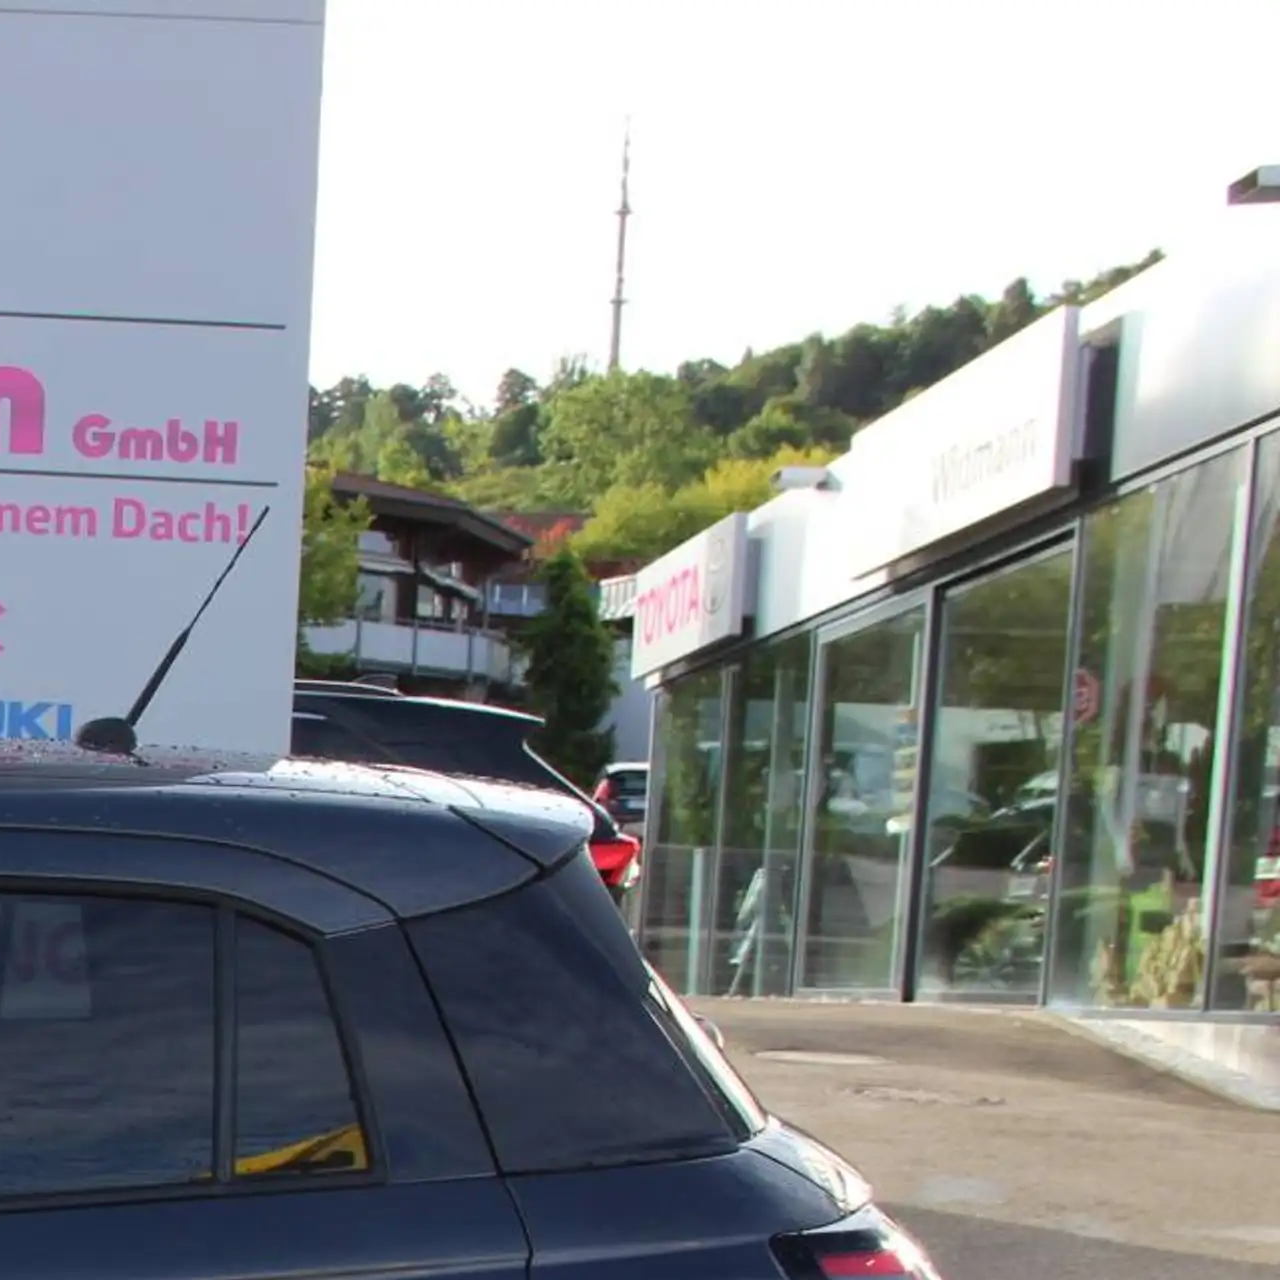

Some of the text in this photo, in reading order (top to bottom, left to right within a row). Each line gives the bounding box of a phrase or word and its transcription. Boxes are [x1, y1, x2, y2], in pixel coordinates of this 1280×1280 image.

[72, 414, 239, 465] GmbH
[112, 497, 250, 545] Dach!
[636, 565, 700, 645] TOYOTA
